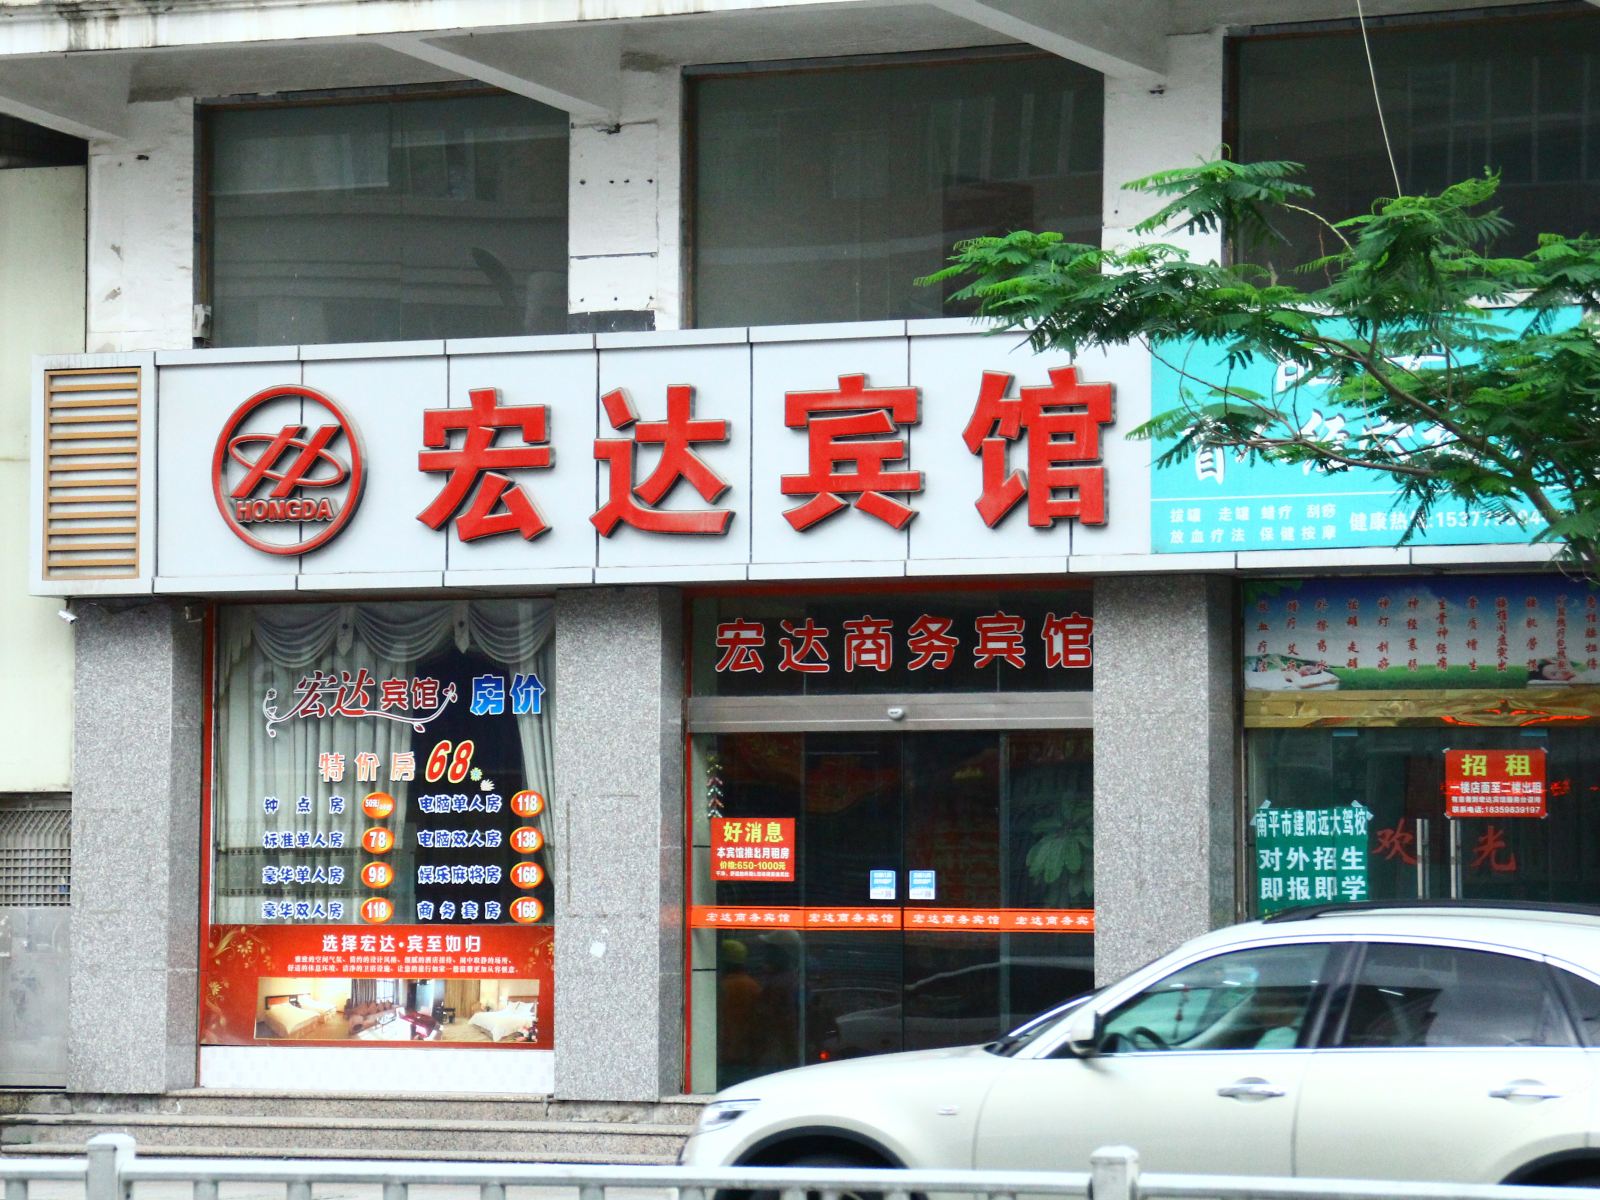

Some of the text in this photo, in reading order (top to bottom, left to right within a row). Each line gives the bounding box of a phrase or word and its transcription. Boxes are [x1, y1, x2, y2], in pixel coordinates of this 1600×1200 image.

[416, 364, 1117, 543] 宏达宾馆
[235, 497, 336, 523] HONGDA
[1170, 525, 1337, 544] 放血疗法 保健按摩
[715, 611, 1093, 673] 宏达商务宾馆
[290, 667, 547, 720] 宏达宾馆 房价
[318, 739, 476, 784] 特价房 68
[1462, 754, 1532, 777] 招租
[1450, 781, 1543, 794] 一楼店面至二楼出租
[263, 796, 346, 815] 钟点房
[418, 794, 539, 814] 电脑单人房 118
[723, 821, 784, 843] 好消息
[1256, 810, 1367, 838] 南平市建阳远大驾校
[262, 830, 387, 849] 标准单人房 78
[417, 829, 538, 849] 电脑双人房 138
[1371, 816, 1517, 872] 欢 光
[716, 847, 790, 859] 本宾馆推出月租房
[1258, 846, 1367, 873] 对外招生
[262, 866, 387, 885] 豪华单人房 98
[417, 865, 538, 885] 娱乐麻将房 168
[1260, 876, 1367, 902] 即报即学
[261, 901, 388, 920] 豪华双人房 118
[417, 900, 538, 920] 商务套房 168
[706, 912, 791, 924] 宏达商务宾馆
[808, 912, 895, 924] 宏达商务宾馆
[912, 913, 1000, 925] 宏达商务宾馆
